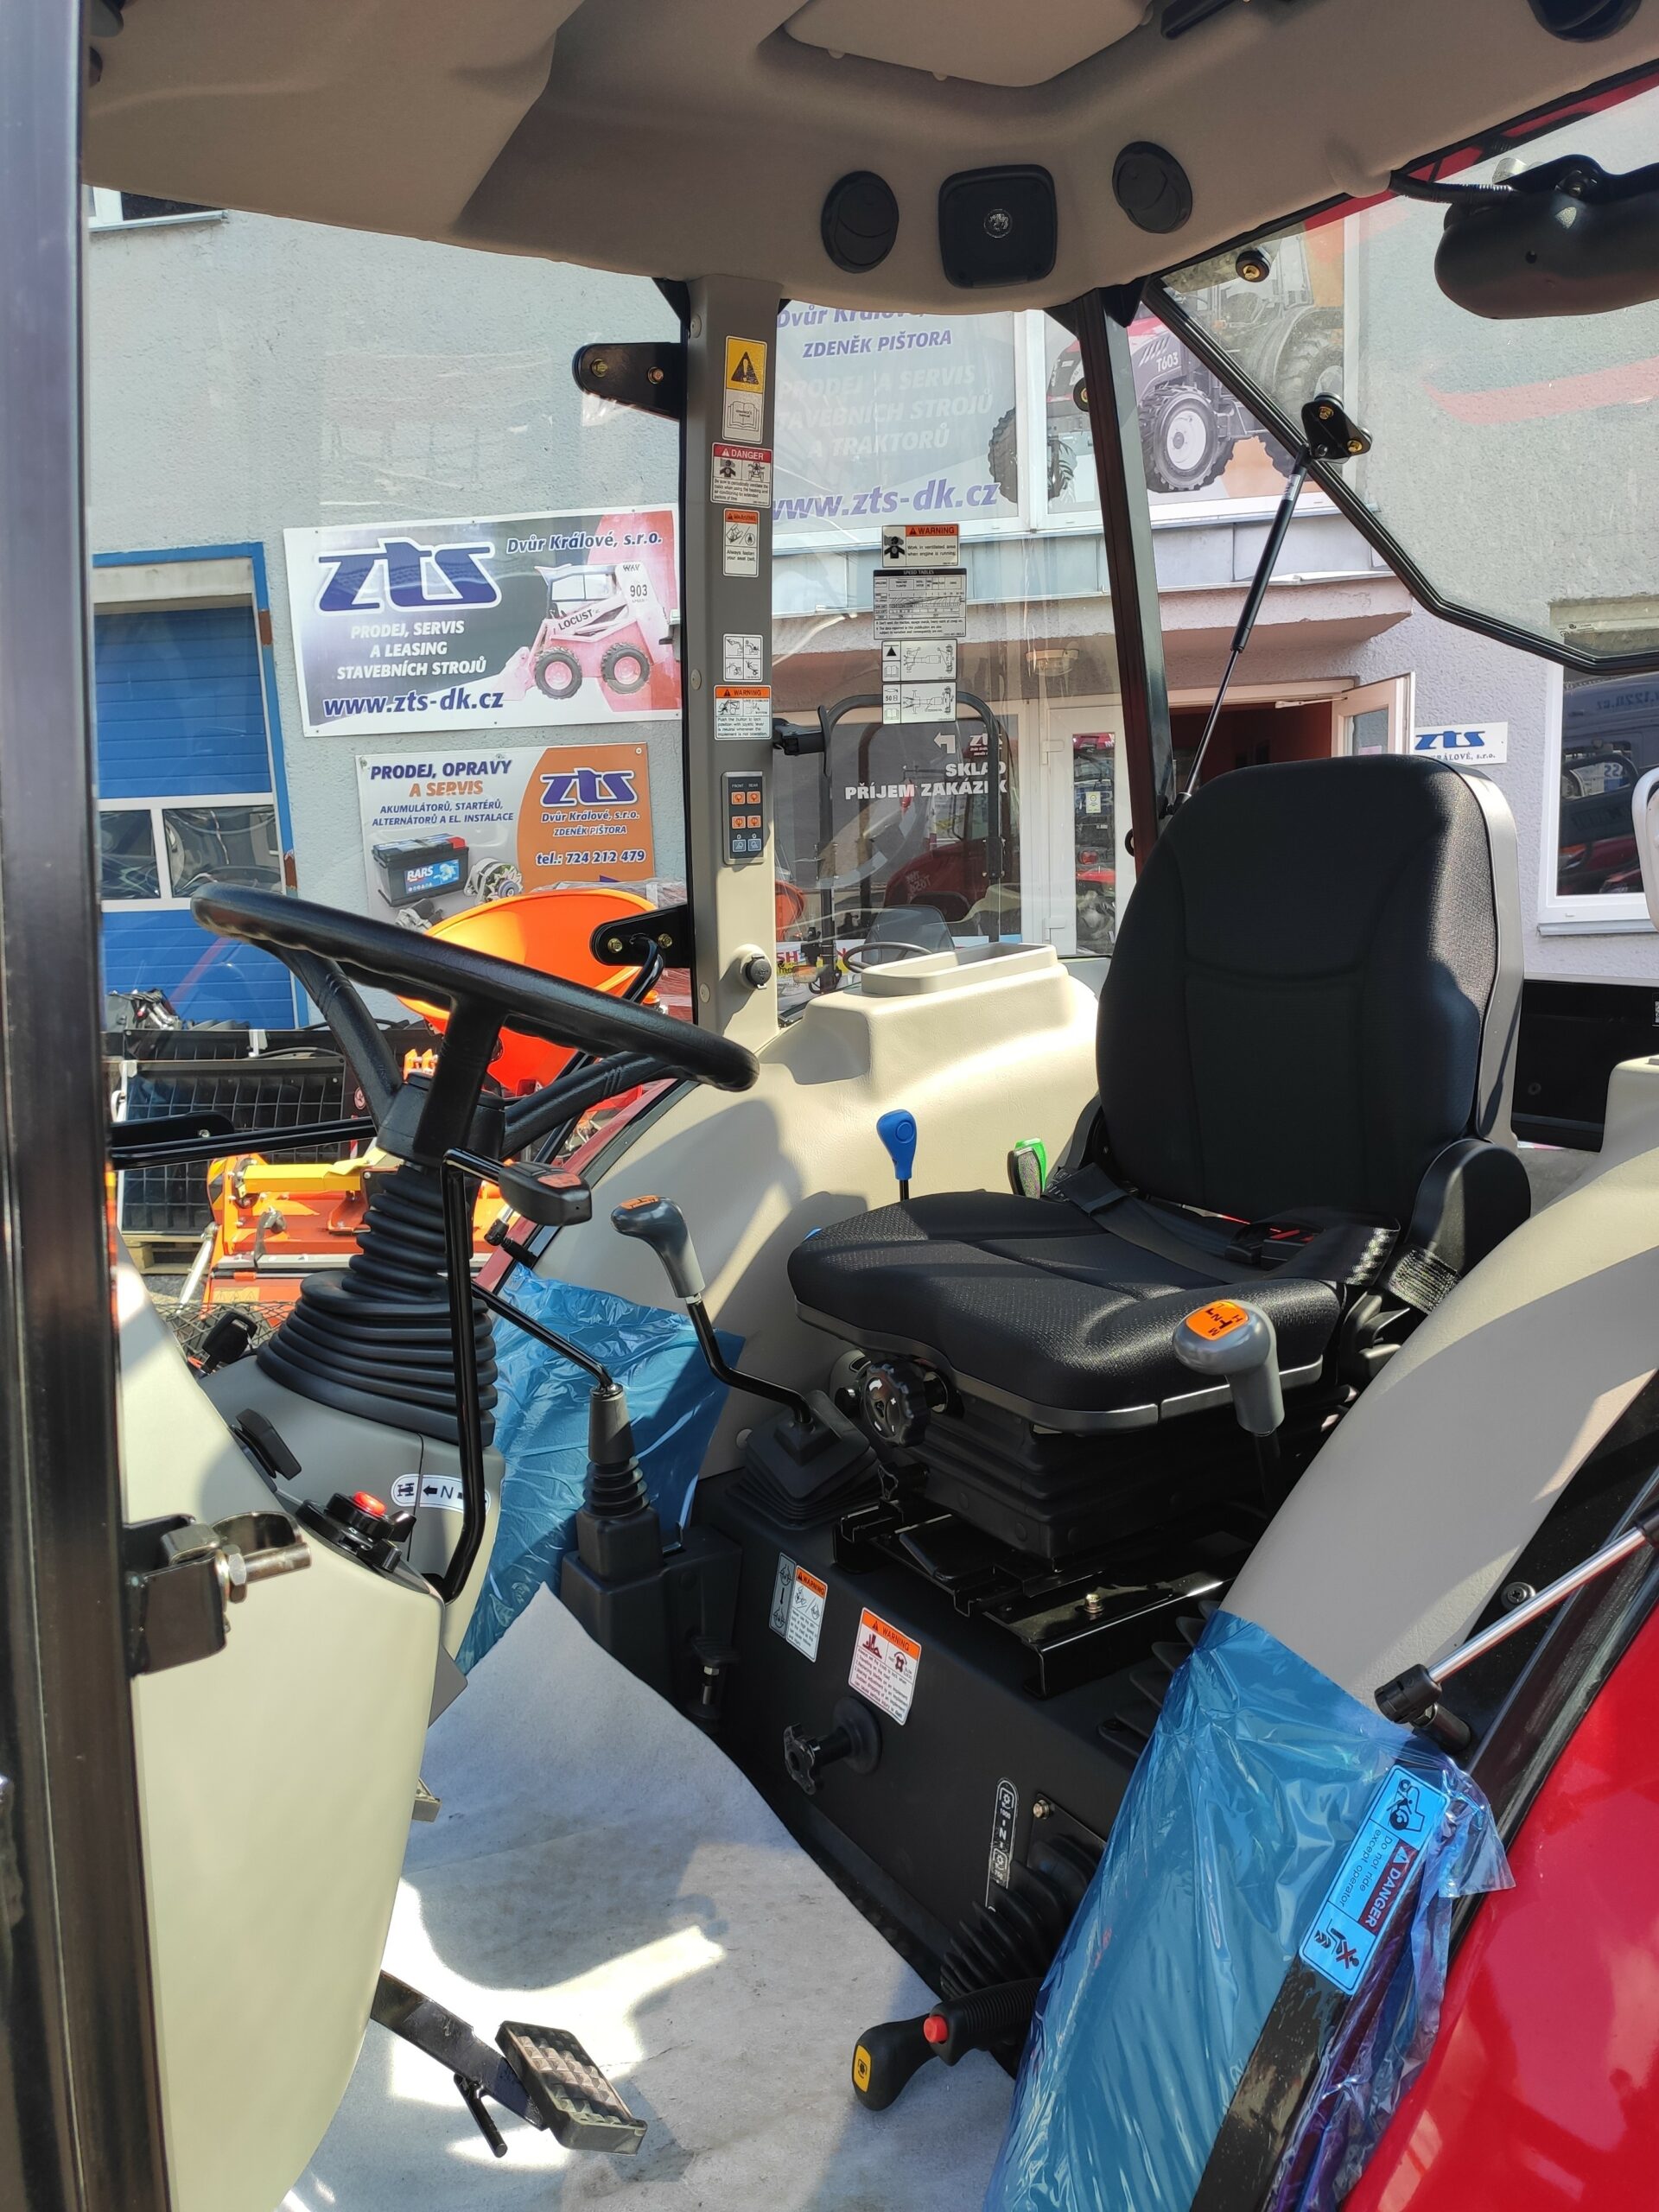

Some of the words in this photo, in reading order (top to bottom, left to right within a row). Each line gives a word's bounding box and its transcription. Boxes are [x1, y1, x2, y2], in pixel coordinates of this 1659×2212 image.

[803, 335, 872, 358] ZDENĚK
[878, 330, 951, 352] PIŠTORA
[1156, 353, 1179, 372] T603
[779, 376, 868, 400] PRODEJ
[877, 374, 892, 389] A
[899, 365, 975, 389] SERVIS
[911, 390, 992, 419] STROJŮ
[808, 443, 822, 458] A
[832, 423, 950, 456] TRAKTORŮ
[731, 449, 764, 461] DANGER
[507, 534, 544, 553] Dvůr
[550, 531, 618, 550] Králové,
[624, 532, 662, 545] s.r.o.
[318, 537, 501, 614] zts
[630, 584, 647, 597] 903
[351, 623, 409, 639] PRODEJ,
[413, 620, 465, 636] SERVIS
[558, 609, 594, 631] LOCUST
[370, 645, 381, 658] A
[385, 641, 448, 658] LEASING
[337, 660, 428, 679] STAVEBNÍCH
[431, 655, 486, 675] STROJŮ
[324, 687, 504, 716] www.zts-dk.cz
[1414, 730, 1485, 751] zts
[370, 764, 436, 779] PRODEJ,
[442, 760, 512, 777] OPRAVY
[409, 785, 421, 798] A
[427, 780, 483, 796] SERVIS
[540, 767, 639, 807] zts
[845, 781, 915, 799] PŘÍJEM
[379, 799, 454, 814] AKUMULÁTORŮ,
[454, 798, 503, 811] STARTÉRŮ,
[372, 813, 438, 827] ALTERNÁTORŮ
[440, 816, 447, 824] A
[464, 811, 514, 823] INSTALACE
[541, 810, 567, 823] Dvůr
[569, 809, 612, 822] Králové,
[613, 811, 639, 821] s.r.o.
[553, 824, 588, 836] ZDENĚK
[589, 823, 627, 835] PIŠTORA
[536, 852, 563, 866] tel.:
[565, 852, 590, 865] 724
[592, 851, 616, 863] 212
[620, 849, 646, 862] 479
[407, 866, 434, 881] BARS
[440, 1485, 454, 1499] N
[803, 1575, 824, 1595] WARNING
[881, 1626, 910, 1652] WARNING
[999, 1829, 1007, 1840] N
[1362, 1828, 1381, 1859] except
[1381, 1835, 1393, 1851] Do
[1372, 1853, 1382, 1870] not
[1341, 1865, 1363, 1907] operator
[1360, 1872, 1373, 1892] ride
[1365, 1868, 1402, 1929] DANGER
